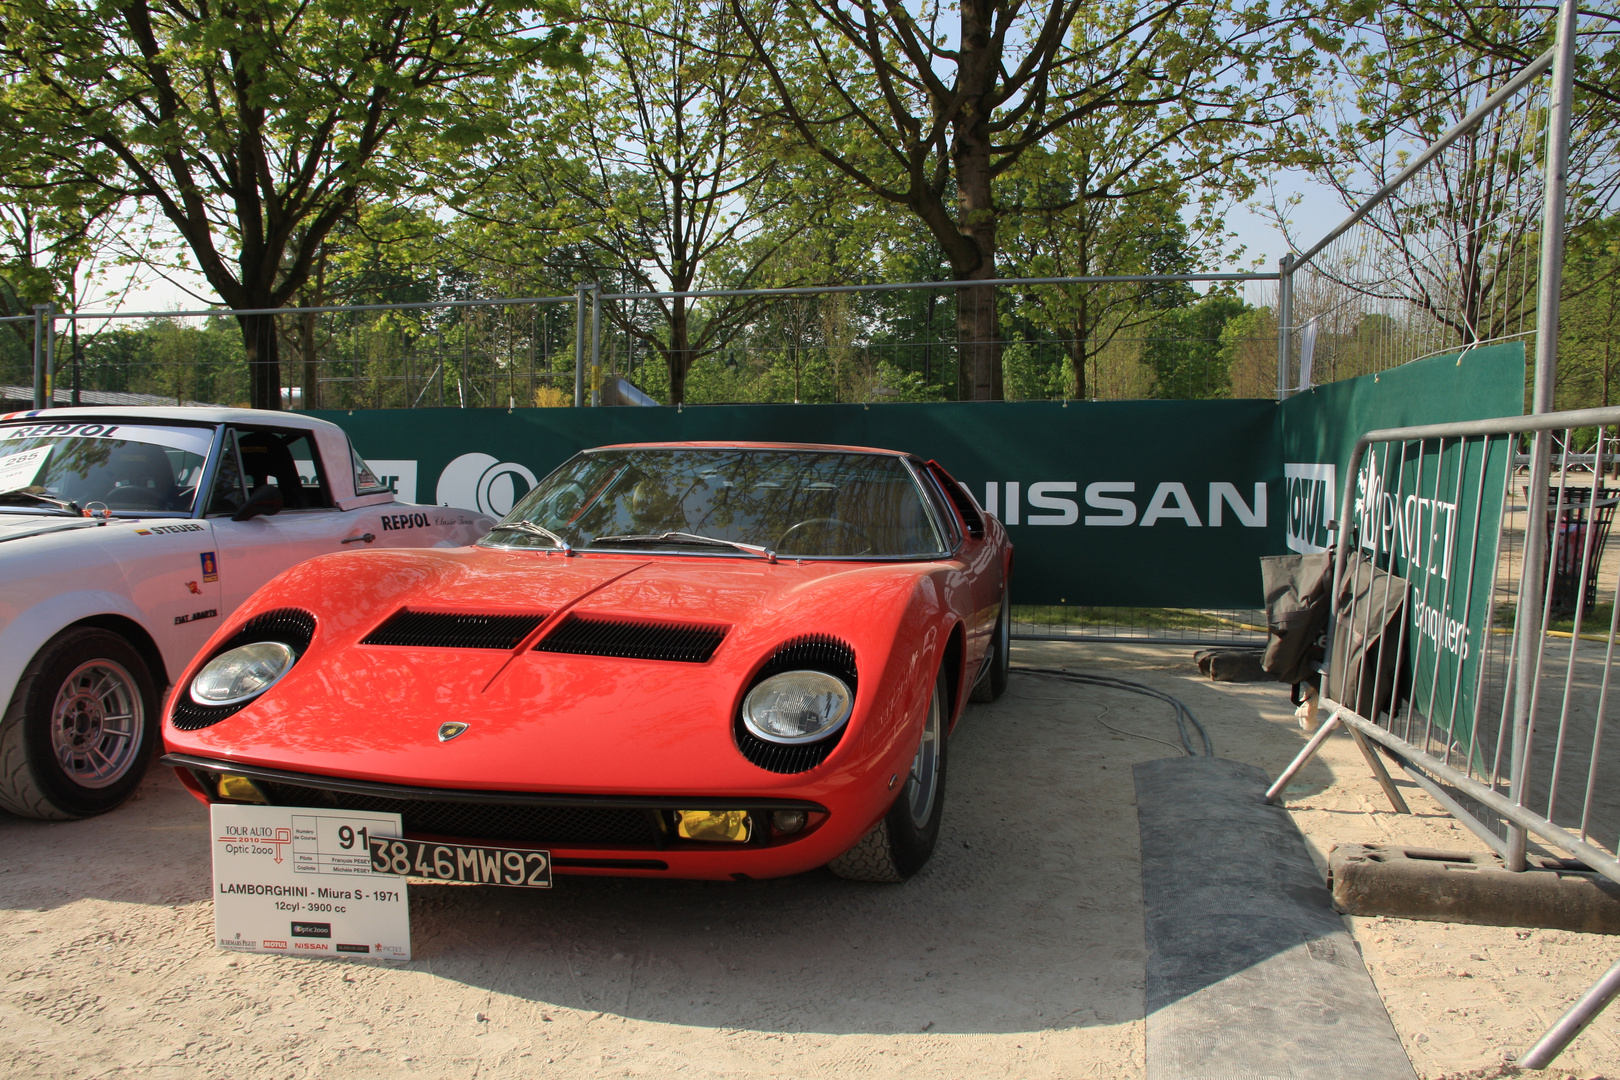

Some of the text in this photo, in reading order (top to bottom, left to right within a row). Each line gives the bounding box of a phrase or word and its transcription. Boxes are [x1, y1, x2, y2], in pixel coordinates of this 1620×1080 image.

[8, 424, 119, 439] REPSOL
[4, 451, 39, 467] 285
[381, 512, 431, 531] REPSOL
[151, 523, 205, 535] STEUER
[174, 615, 190, 625] FIAT
[226, 826, 273, 837] TOUR AUTO
[338, 825, 369, 851] 91
[225, 843, 274, 855] Optic 2000
[220, 883, 308, 897] LAMBORGHINI
[318, 888, 351, 899] Miura
[354, 890, 363, 900] S
[373, 891, 399, 902] 1971
[275, 902, 300, 912] 12cyl
[307, 903, 332, 912] 3900
[334, 905, 346, 913] cc
[264, 941, 287, 949] MOTUL
